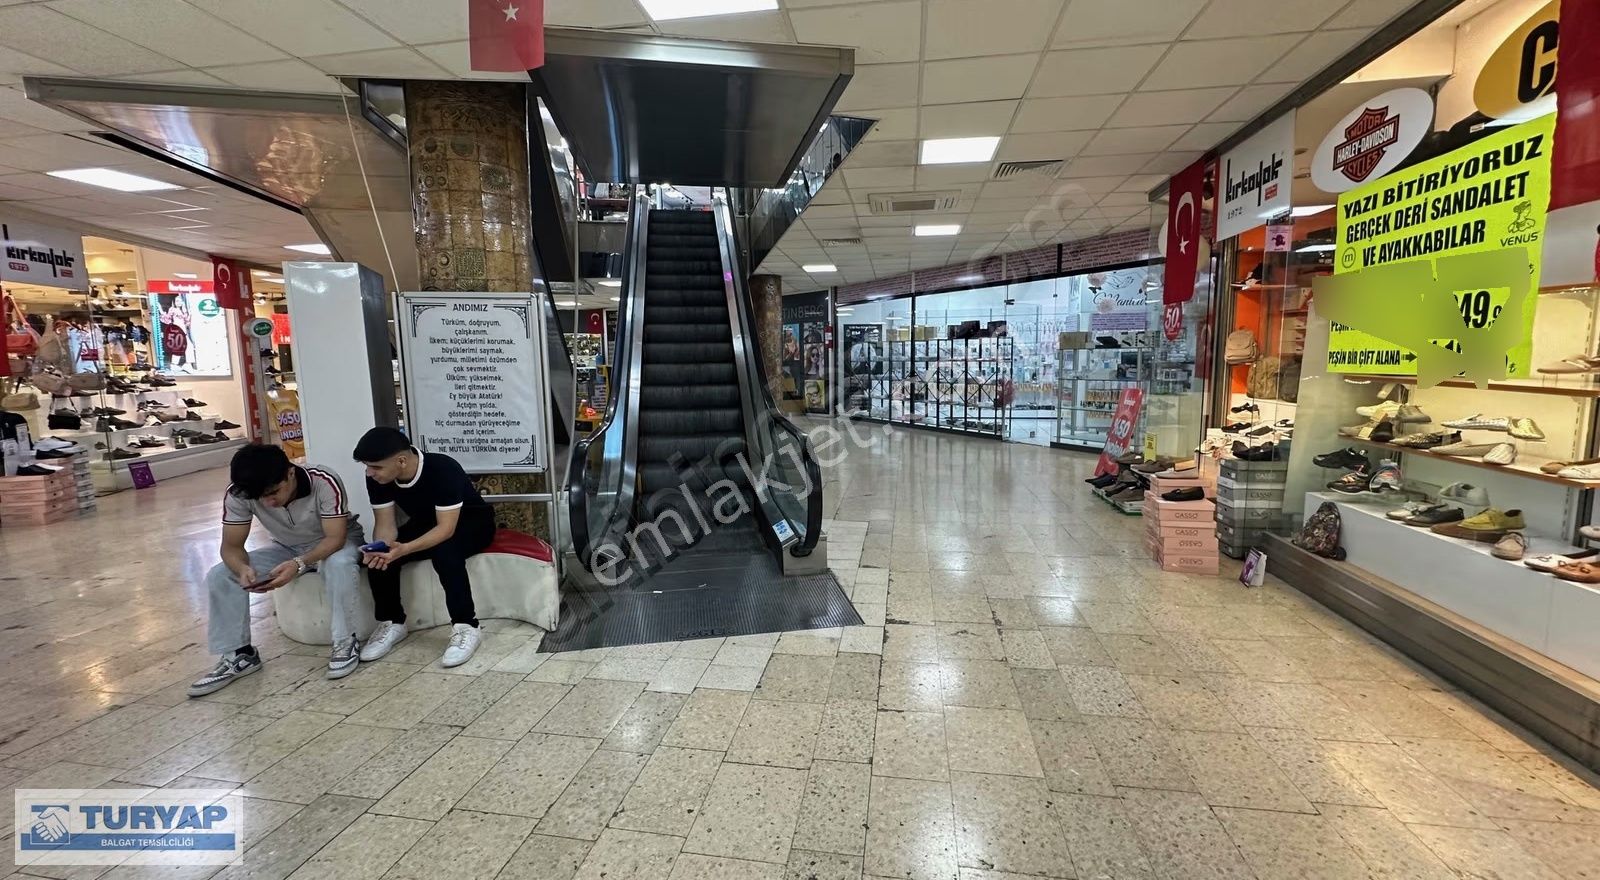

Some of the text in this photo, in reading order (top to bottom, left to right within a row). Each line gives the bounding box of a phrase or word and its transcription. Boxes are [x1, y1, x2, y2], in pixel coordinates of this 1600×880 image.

[1350, 114, 1384, 138] MOTOR
[1336, 122, 1395, 164] HARLEY-DAVIDSON
[1347, 150, 1379, 177] CYCLES
[1344, 134, 1544, 219] YAZI BİTİRİYORUZ
[1346, 171, 1530, 244] GERÇEK DERİ SANDALET
[1363, 219, 1486, 267] VE AYAKKABILAR
[1500, 231, 1540, 247] VENUS
[452, 303, 488, 312] ANDIMIZ
[469, 319, 501, 327] doğruyum,
[442, 347, 477, 355] büyüklerimi
[450, 338, 485, 346] küçüklerimi
[1328, 348, 1400, 368] PEŞİN BİR ÇİFT ALANA
[448, 411, 482, 419] gösterdiğin
[471, 444, 497, 452] TÜRKÜM
[499, 446, 521, 454] diyene!
